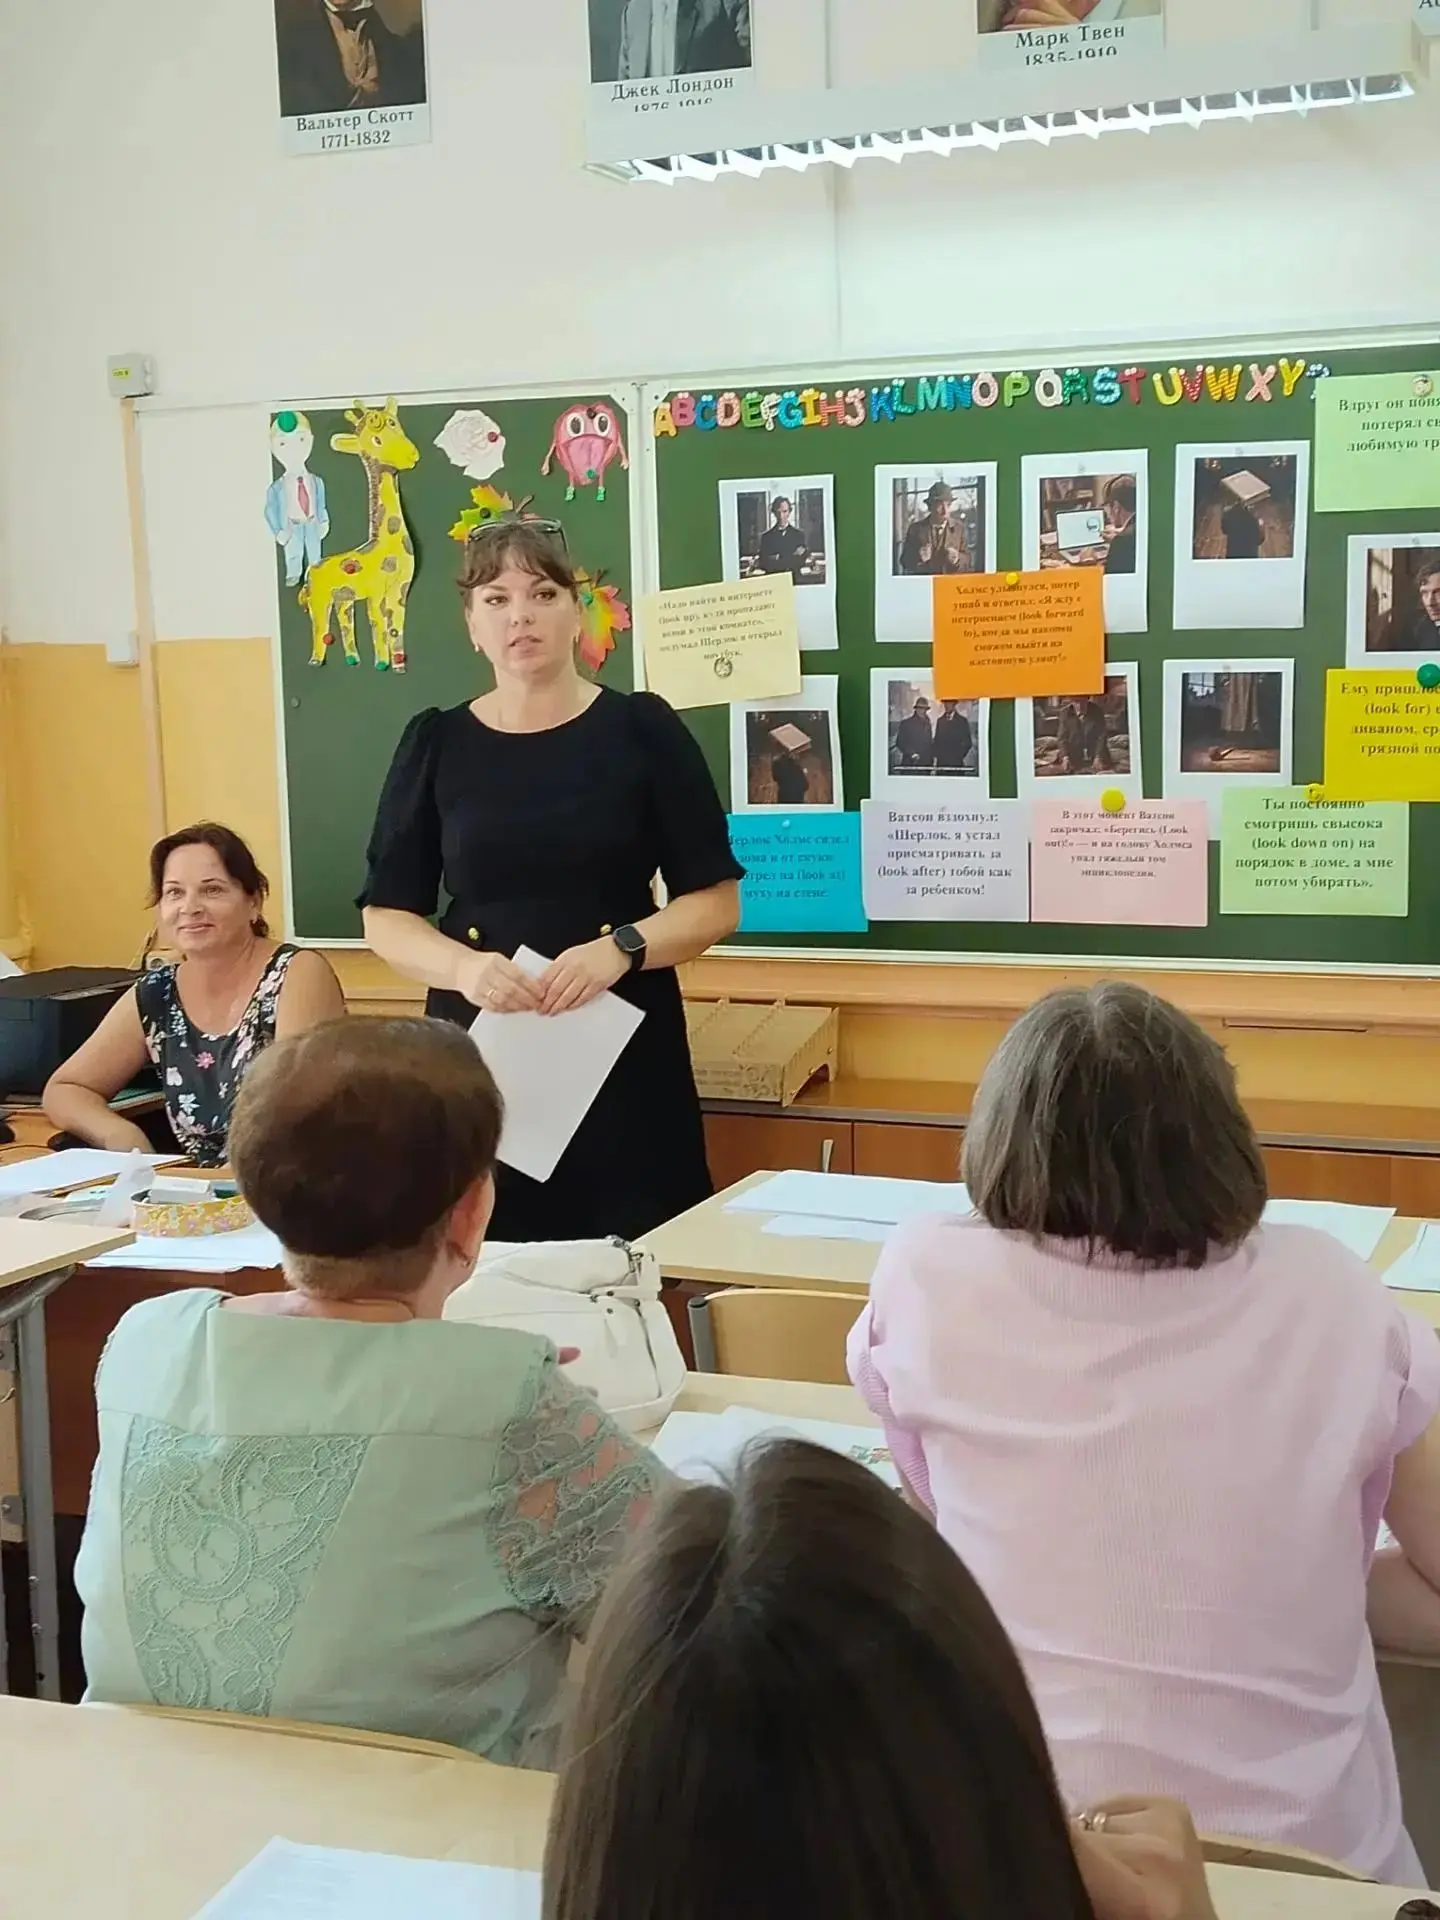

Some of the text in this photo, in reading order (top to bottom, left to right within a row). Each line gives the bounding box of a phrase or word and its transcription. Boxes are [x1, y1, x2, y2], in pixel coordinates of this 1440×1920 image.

[1016, 25, 1125, 49] Марк Твен
[611, 77, 734, 101] Джек Лондон
[297, 110, 414, 132] Вальтер Скотт
[321, 130, 391, 149] 1771-1832
[1387, 400, 1403, 409] он
[1361, 418, 1421, 432] потерял
[1346, 439, 1418, 452] любимую
[1365, 702, 1400, 715] (look
[1405, 702, 1431, 715] for)
[1262, 798, 1284, 810] Ты
[888, 811, 933, 822] Ватсон
[1244, 819, 1383, 832] смотришь свысока
[965, 832, 1000, 843] устал
[1252, 837, 1375, 850] (look down on) на
[887, 850, 985, 861] присматривать
[1235, 859, 1295, 871] порядок
[1353, 859, 1361, 868] а
[1365, 859, 1394, 868] мне
[878, 866, 1012, 878] (look after) тобой как
[1255, 878, 1298, 888] потом
